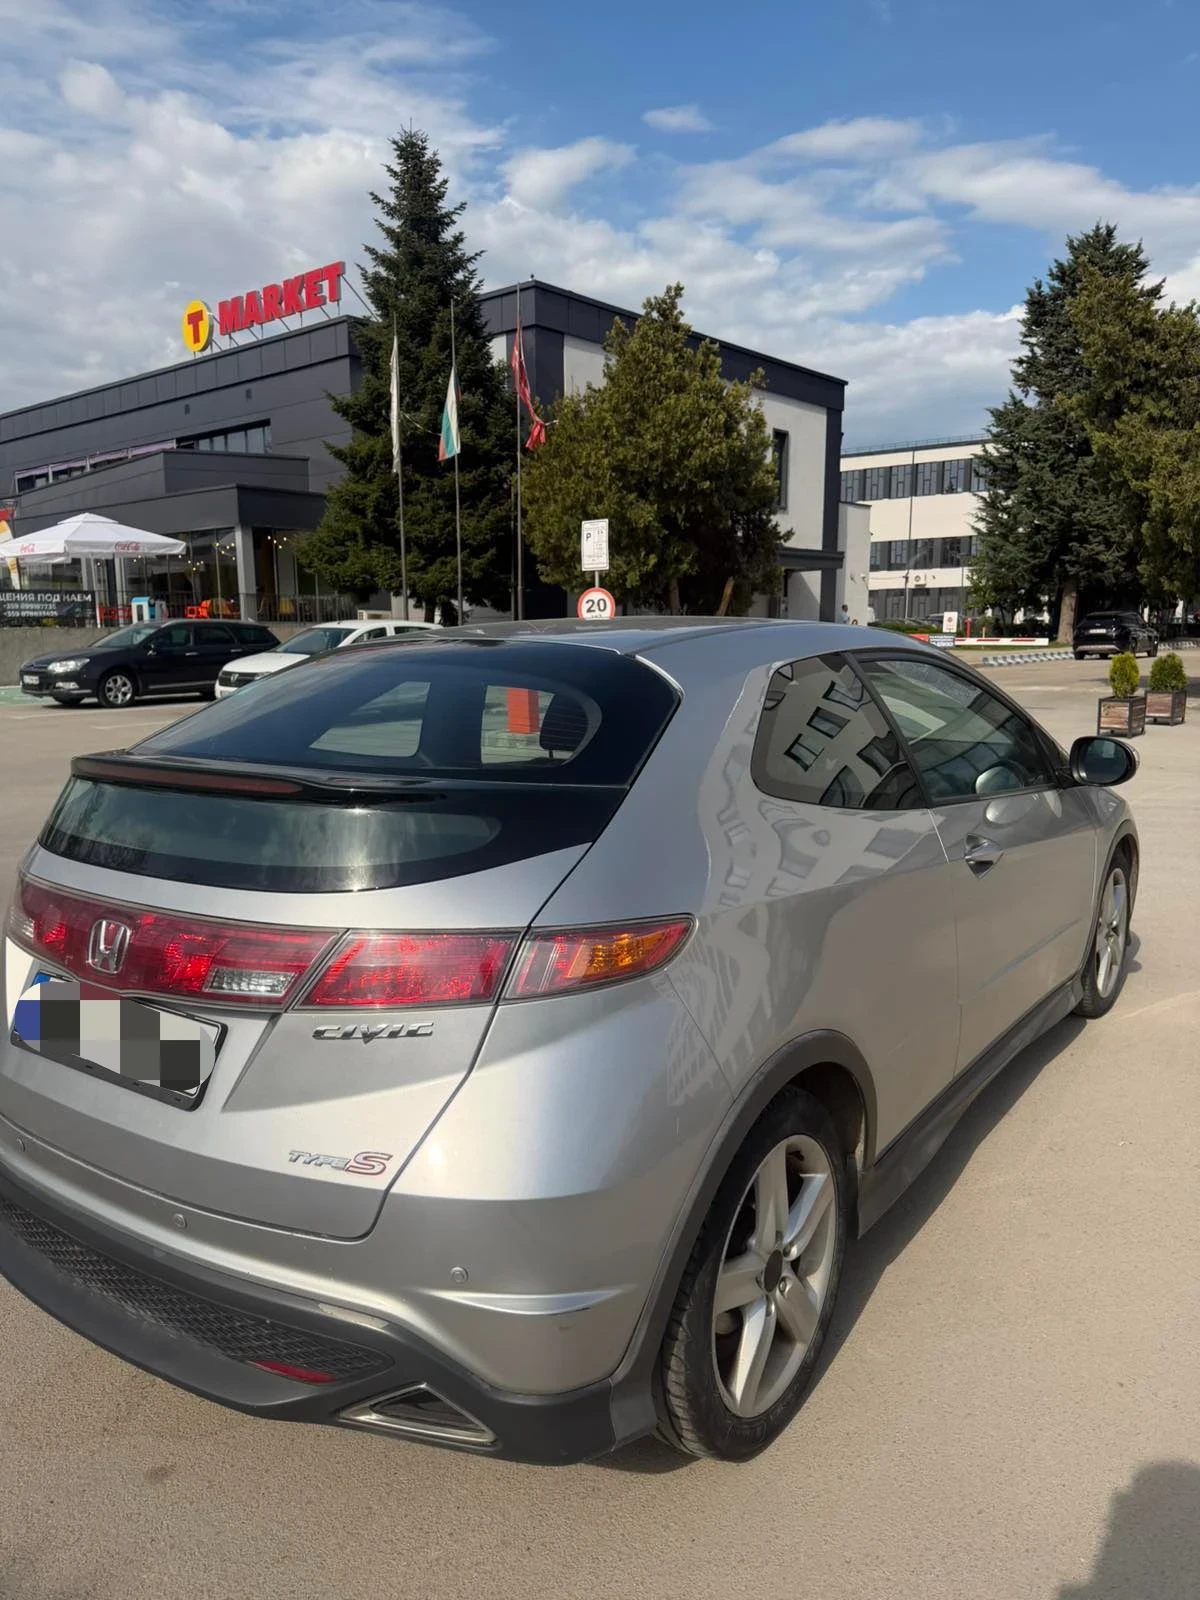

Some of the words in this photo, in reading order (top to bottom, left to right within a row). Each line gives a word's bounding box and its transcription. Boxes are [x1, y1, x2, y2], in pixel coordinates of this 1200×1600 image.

[187, 309, 204, 345] T
[218, 261, 345, 336] MARKET
[37, 593, 60, 603] ПОД
[62, 593, 92, 602] НАЕМ
[585, 598, 607, 613] 20
[312, 1022, 434, 1044] CIVIC
[288, 1150, 349, 1171] TYPE
[345, 1151, 393, 1176] S
